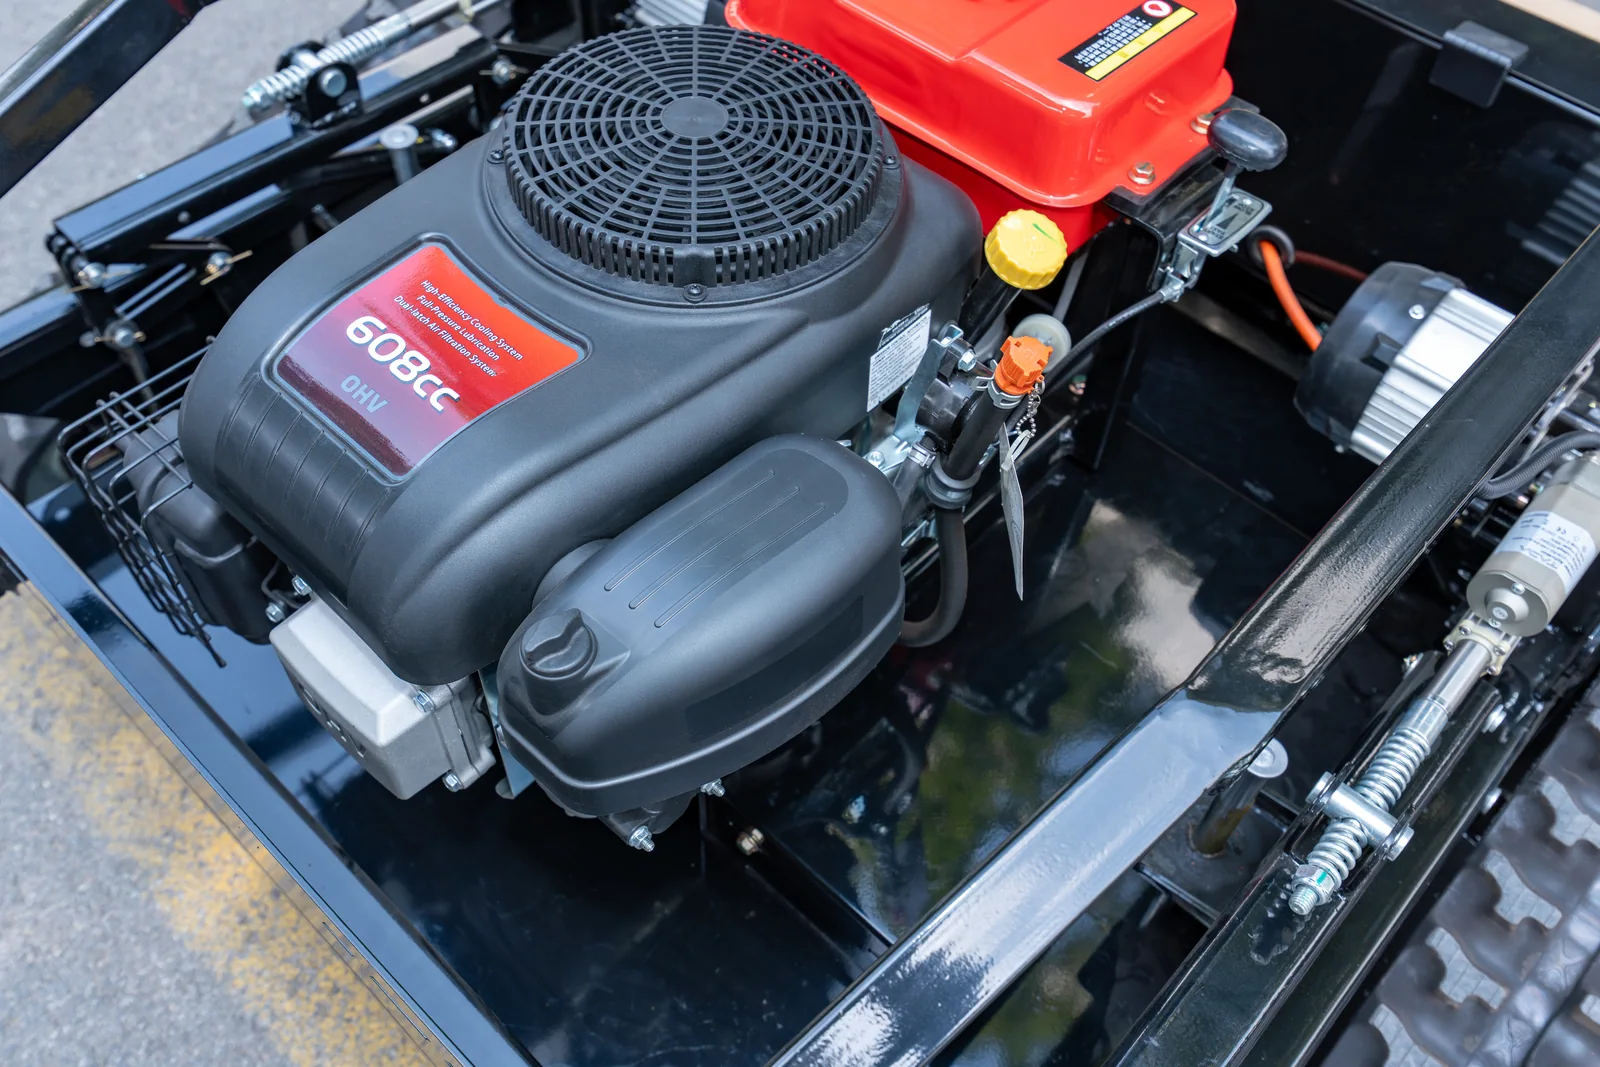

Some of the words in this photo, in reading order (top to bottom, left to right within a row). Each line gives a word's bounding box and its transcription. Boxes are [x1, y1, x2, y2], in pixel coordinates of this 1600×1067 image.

[393, 295, 430, 325] Dual-latch
[427, 322, 441, 334] Air
[437, 329, 471, 358] Filtration
[468, 354, 498, 377] System
[416, 294, 461, 331] Full-Pressure
[459, 328, 500, 361] Lubrication
[420, 279, 472, 321] High-Efficiency
[470, 318, 498, 342] Cooling
[496, 338, 524, 361] System
[340, 374, 388, 413] OHV
